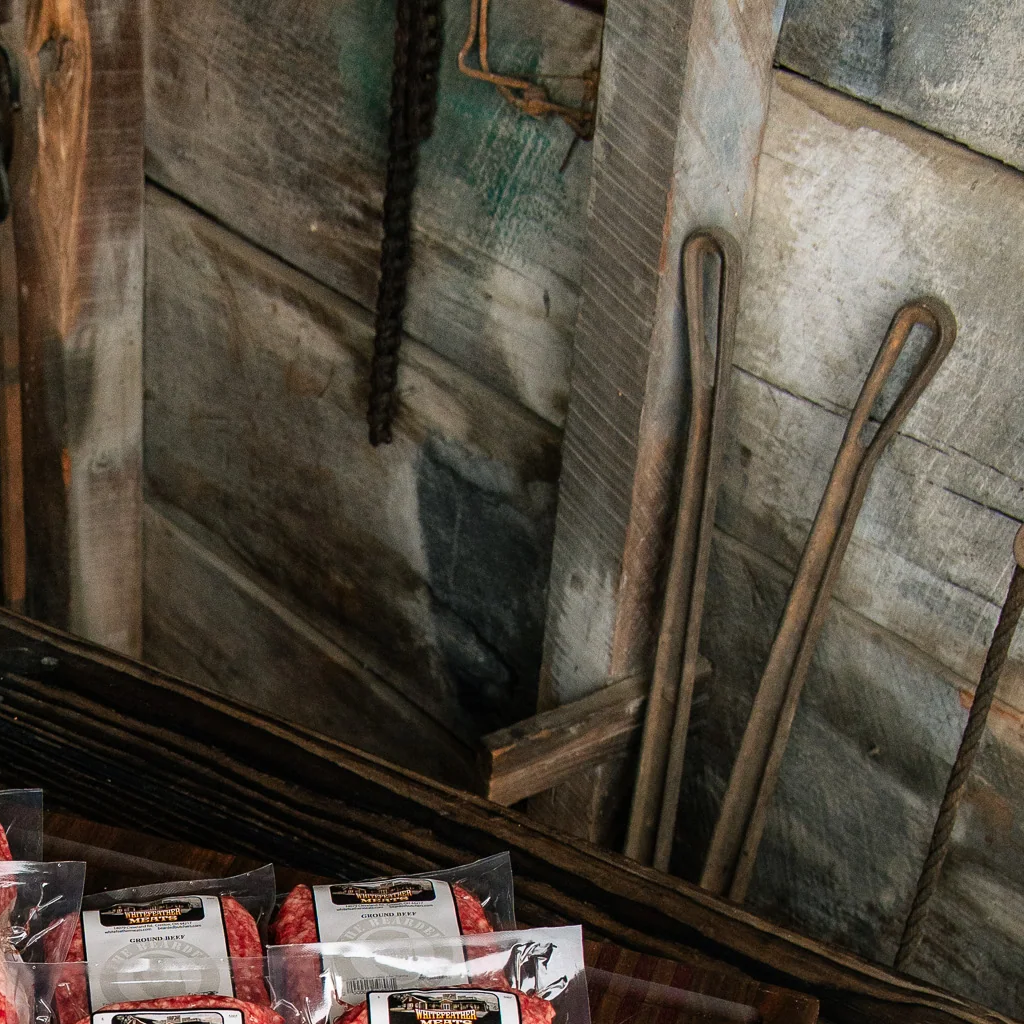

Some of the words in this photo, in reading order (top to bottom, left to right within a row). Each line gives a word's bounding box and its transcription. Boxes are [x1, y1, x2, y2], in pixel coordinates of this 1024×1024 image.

[356, 890, 412, 899] WHITEFEATHER
[125, 908, 182, 918] WHITEFEATHER
[129, 915, 177, 924] MEATS
[415, 1009, 477, 1020] WHITEFEATHER
